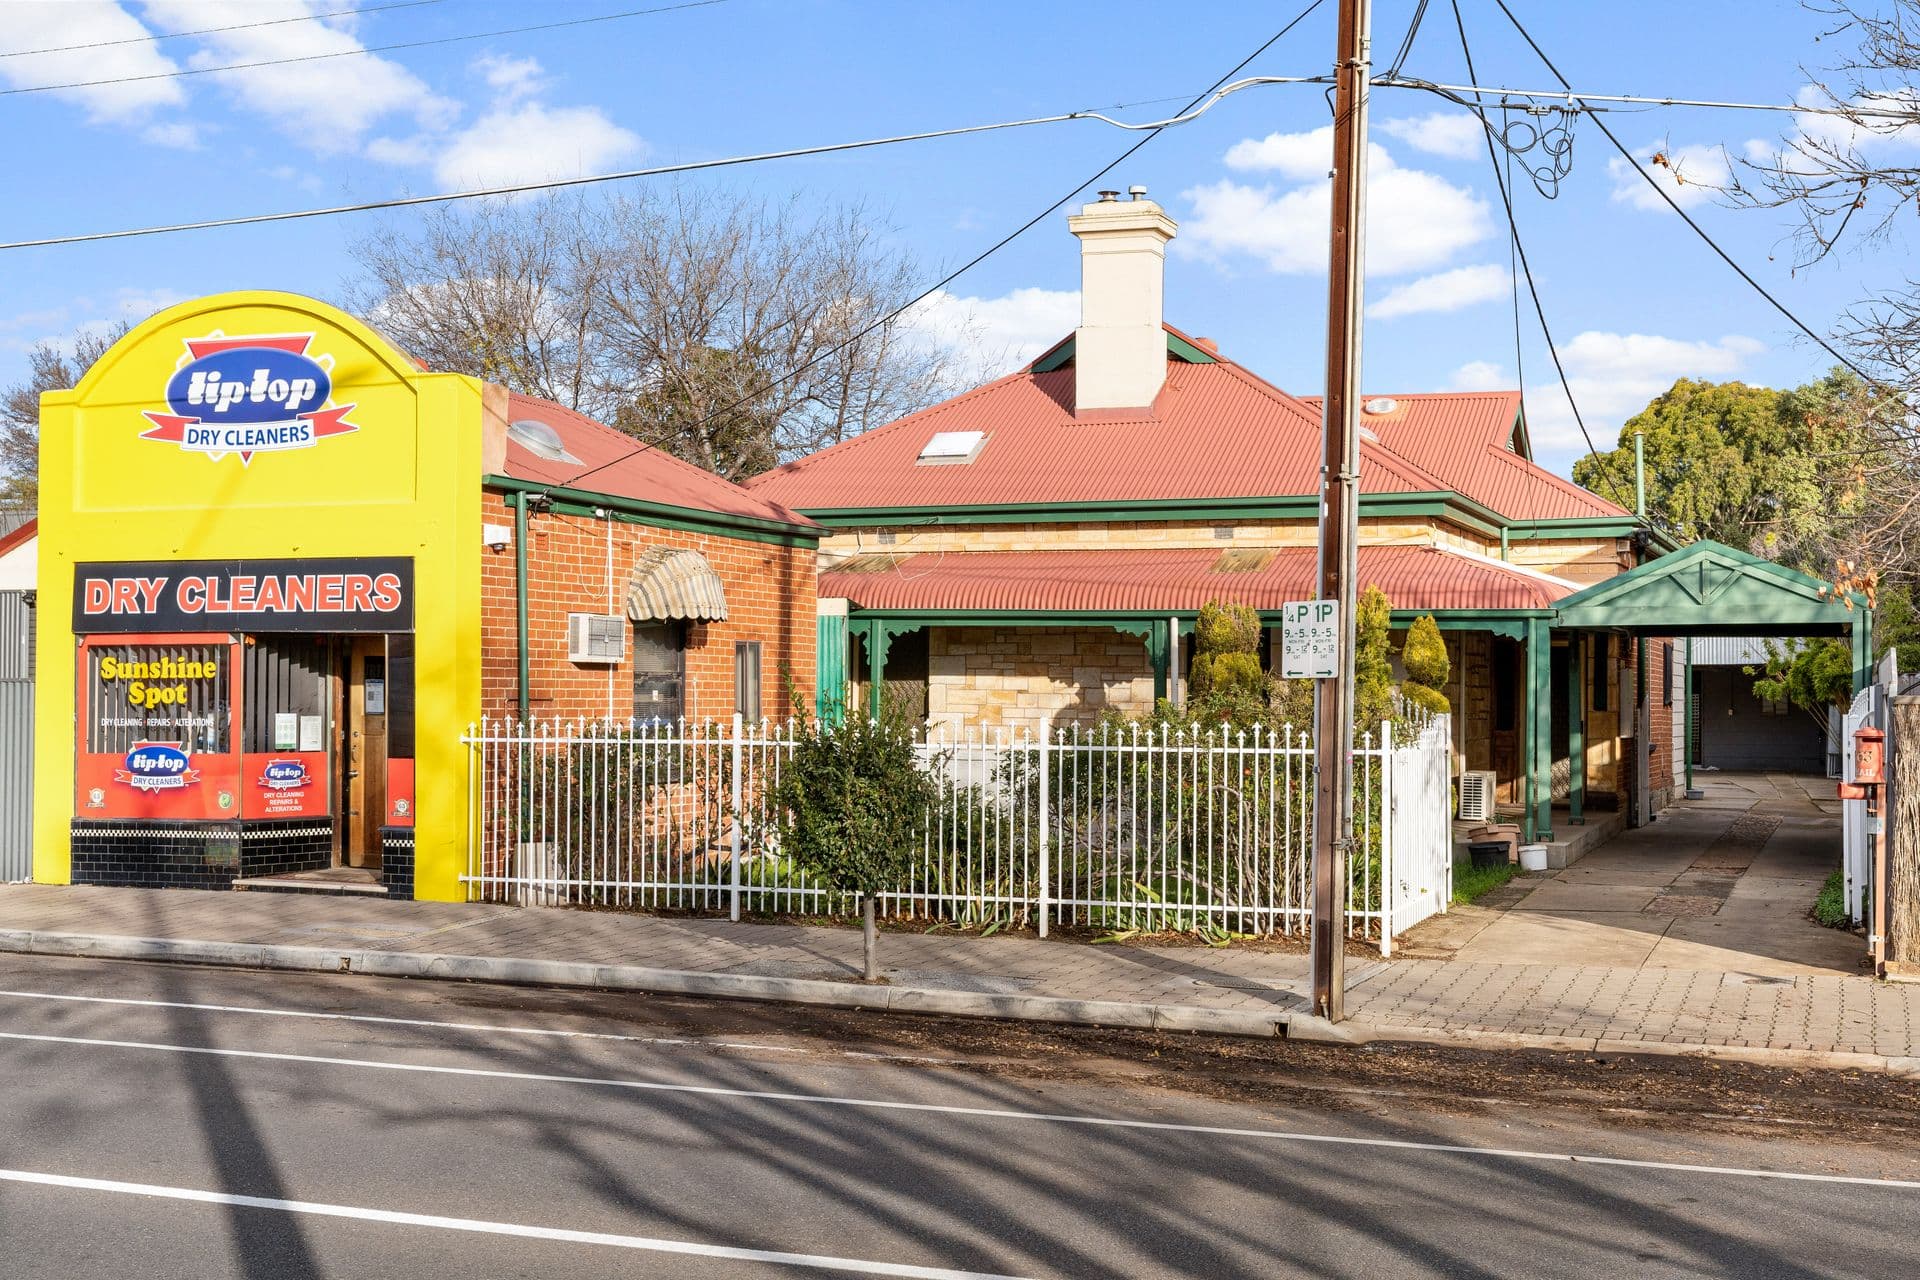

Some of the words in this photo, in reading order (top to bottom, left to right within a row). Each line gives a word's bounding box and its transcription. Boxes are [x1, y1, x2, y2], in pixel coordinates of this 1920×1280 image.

[187, 428, 221, 446] DRY
[225, 424, 310, 446] CLEANERS
[84, 577, 168, 615] DRY
[176, 573, 402, 613] CLEANERS
[1315, 604, 1333, 622] 1P
[100, 656, 217, 679] Sunshine
[128, 681, 188, 709] Spot
[101, 718, 114, 727] DRY
[114, 718, 143, 727] CLEANING
[146, 718, 171, 727] REPAIRS
[174, 718, 214, 727] ALTERATIONS
[133, 777, 147, 785] DRY
[148, 775, 182, 785] CLEANERS
[265, 805, 303, 813] ALTERATIONS
